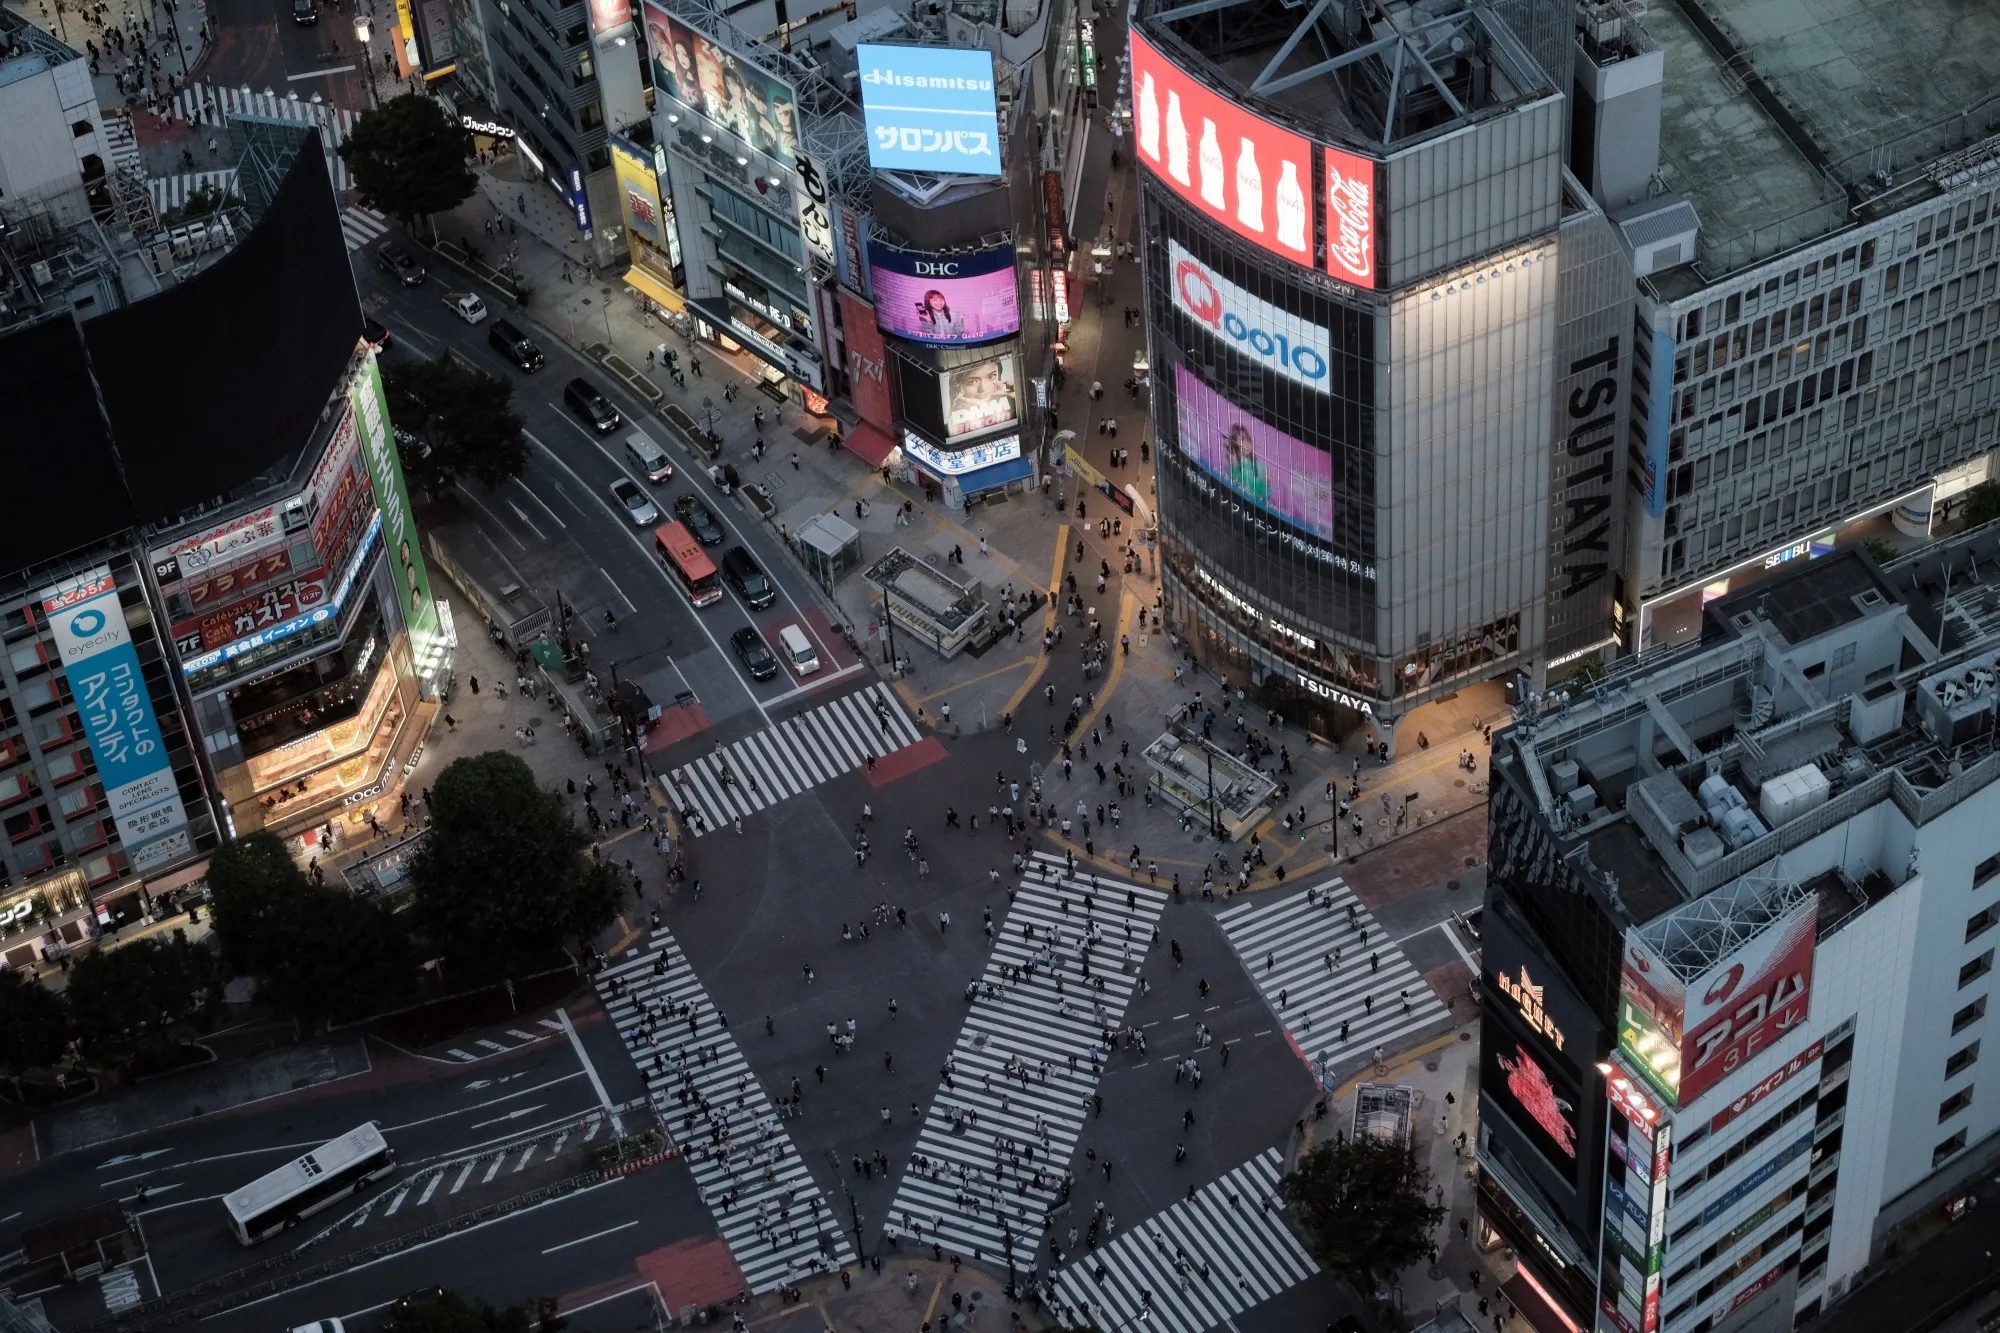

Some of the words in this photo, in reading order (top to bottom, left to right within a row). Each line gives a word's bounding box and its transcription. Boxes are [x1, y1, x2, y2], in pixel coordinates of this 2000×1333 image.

[862, 68, 991, 91] Hisamitsu
[463, 116, 516, 137] グルメタウン
[874, 124, 992, 156] サロンパス
[1330, 164, 1370, 277] Coca-Cola
[915, 261, 959, 276] DHC
[1176, 260, 1327, 379] Qoo10
[911, 439, 1012, 470] 大盛堂書店
[1562, 335, 1620, 600] TSUTAYA
[214, 520, 275, 554] しゃぶ葉
[156, 561, 176, 577] 9F
[1764, 540, 1811, 570] SEIBU
[189, 553, 287, 604] プライス
[301, 588, 323, 602] ガスト
[201, 598, 260, 628] Caféレストラン
[262, 579, 309, 606] ガスト
[234, 600, 292, 635] ガスト
[68, 629, 121, 656] eyecity
[178, 635, 200, 653] 7F
[188, 654, 217, 672] AEON
[225, 618, 309, 658] 英会話イーオン
[205, 624, 232, 641] Café
[1270, 619, 1316, 650] COFFEE
[1431, 623, 1519, 667] TSUTAYA
[110, 662, 155, 756] コンタクトの
[1297, 674, 1373, 715] TSUTAYA
[78, 670, 130, 764] アイシティ
[118, 787, 170, 810] SPECIALISTS
[122, 776, 159, 796] CONTACT
[132, 786, 154, 799] LENS
[1694, 972, 1804, 1069] アコム
[1722, 1028, 1764, 1072] 3F
[1750, 1058, 1802, 1101] アイフル
[1610, 1085, 1654, 1141] アイフル
[1609, 1181, 1647, 1228] レオパレス
[1736, 1282, 1762, 1306] アコム
[1605, 1299, 1634, 1333] アコ
